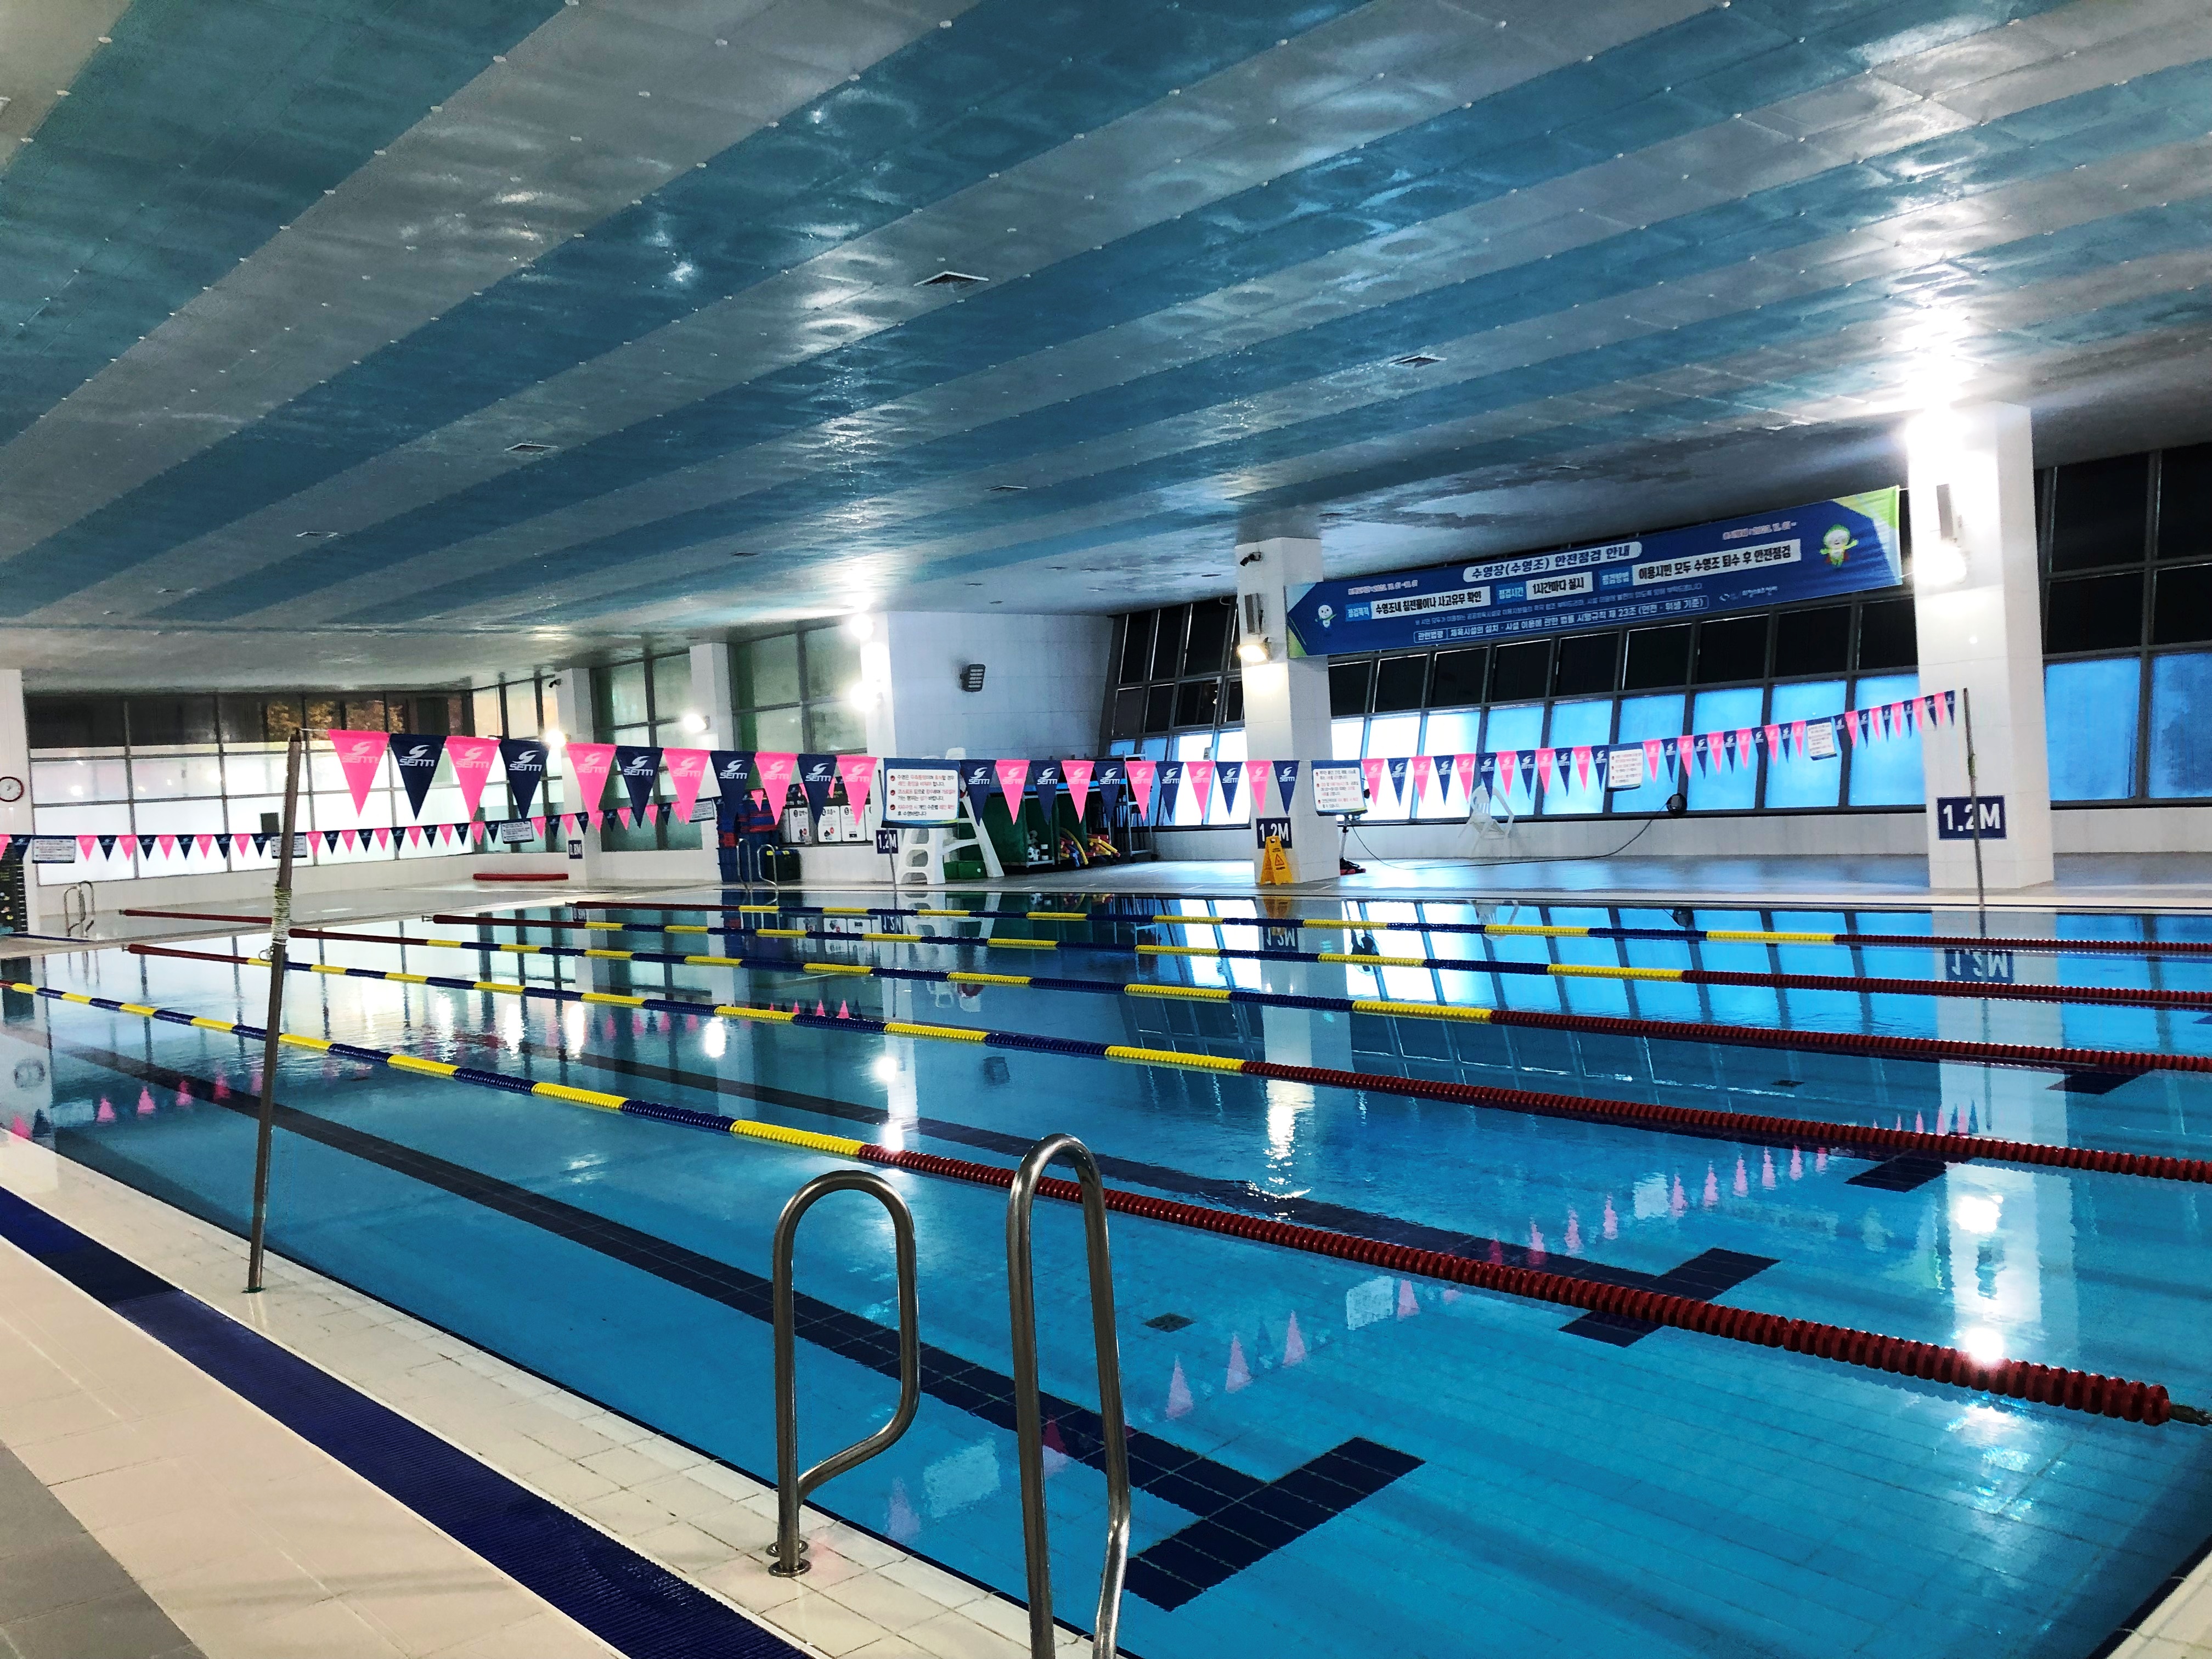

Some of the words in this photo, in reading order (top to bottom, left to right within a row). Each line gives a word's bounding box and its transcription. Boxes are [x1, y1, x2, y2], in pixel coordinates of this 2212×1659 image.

[1472, 558, 1550, 579] 수영장(수영조)
[1555, 550, 1601, 567] 안전점검
[1606, 545, 1630, 560] 안내
[1639, 563, 1672, 580] 이용시민
[1673, 560, 1691, 575] 모두
[1694, 556, 1720, 572] 수영조
[1722, 554, 1741, 568] 퇴수
[1743, 551, 1752, 565] 후
[1753, 544, 1791, 563] 안전점검
[1532, 579, 1567, 595] 1시간마다
[1568, 577, 1585, 590] 실시
[1375, 601, 1402, 614] 수영조내
[1402, 596, 1437, 612] 침전물이나
[1438, 593, 1466, 607] 사고유무
[1466, 590, 1482, 604] 확인
[342, 755, 379, 764] SENTI
[399, 758, 435, 767] SENTI
[455, 760, 490, 769] SENTI
[509, 763, 543, 772] SENTI
[623, 768, 654, 776] SENTI
[673, 769, 703, 777] SENTI
[1943, 803, 2001, 832] 1.2M
[1259, 822, 1290, 842] 12M
